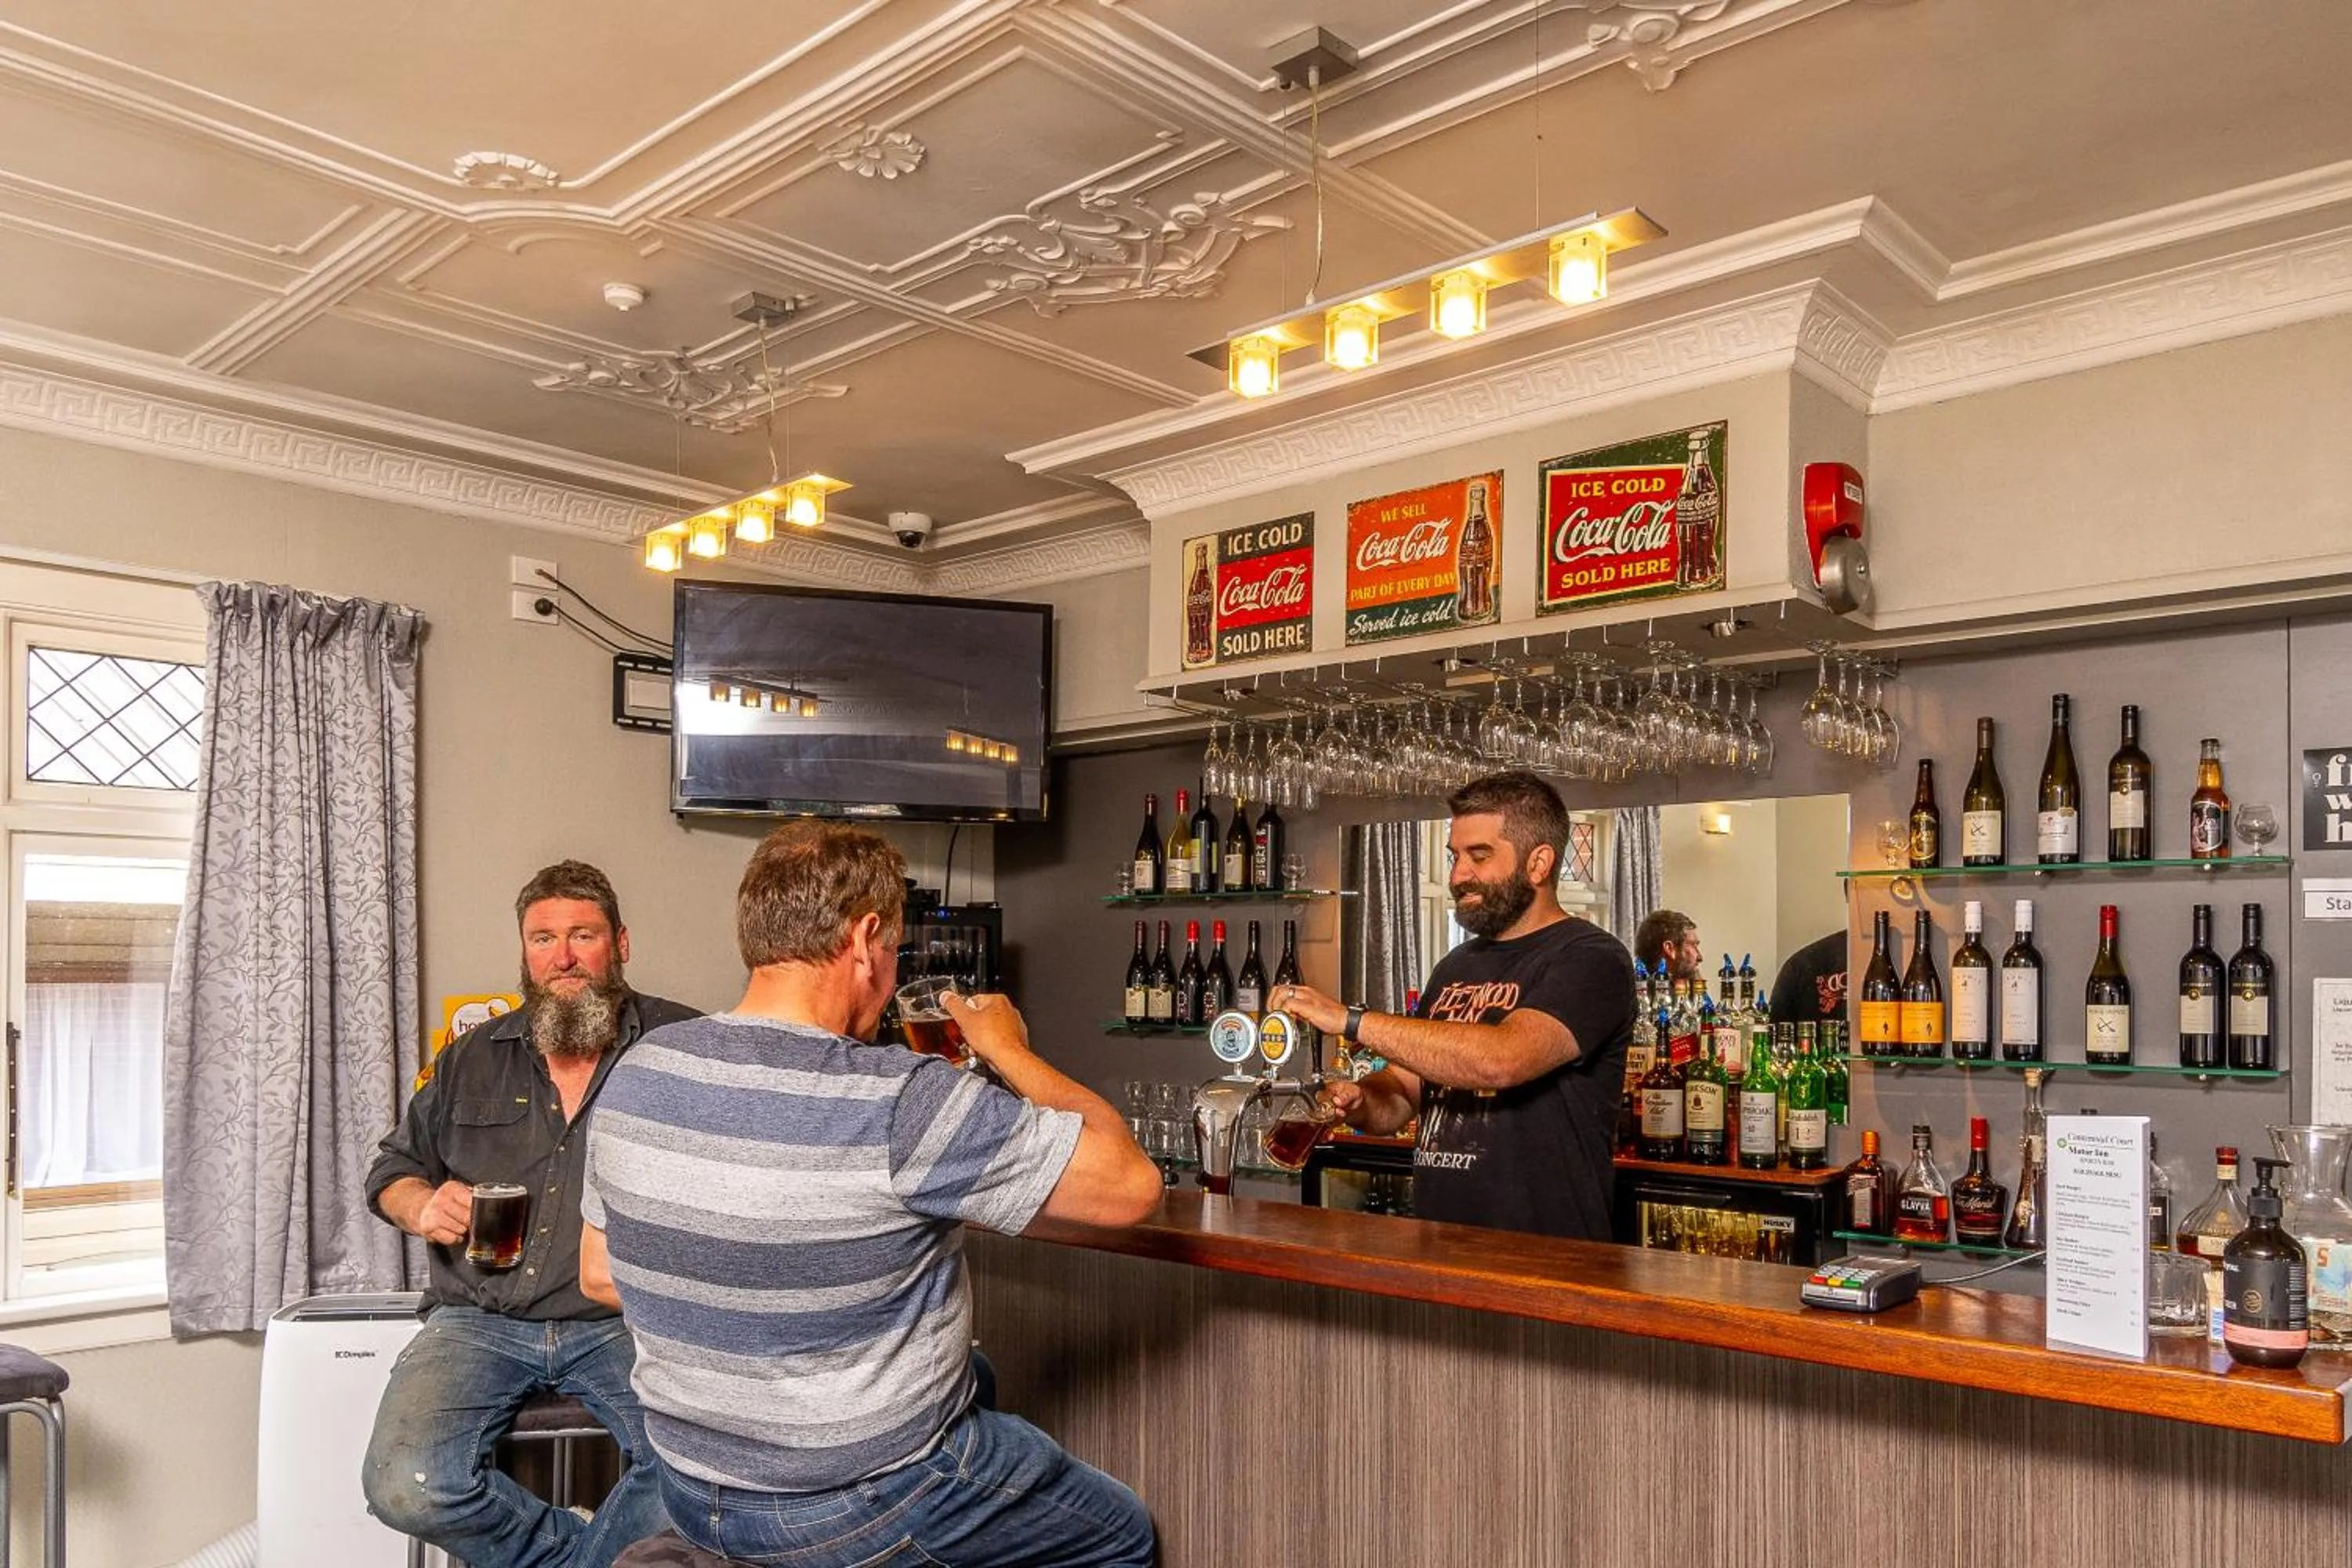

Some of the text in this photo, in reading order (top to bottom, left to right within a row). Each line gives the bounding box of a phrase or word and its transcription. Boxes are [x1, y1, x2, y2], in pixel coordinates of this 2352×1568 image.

[1571, 477, 1665, 498] ICE COLD
[1381, 504, 1426, 523] WE SELL
[1228, 523, 1302, 556] ICE COLD
[1356, 517, 1454, 572] Coca-Cola
[1555, 499, 1676, 562] Coca-Cola
[1351, 572, 1456, 601] PART OF EVERY DAY
[1561, 558, 1671, 589] SOLD HERE
[1220, 564, 1307, 616] Coca-Cola
[1348, 598, 1454, 635] Served ice cold
[1223, 623, 1305, 655] SOLD HERE
[2325, 754, 2352, 786] f
